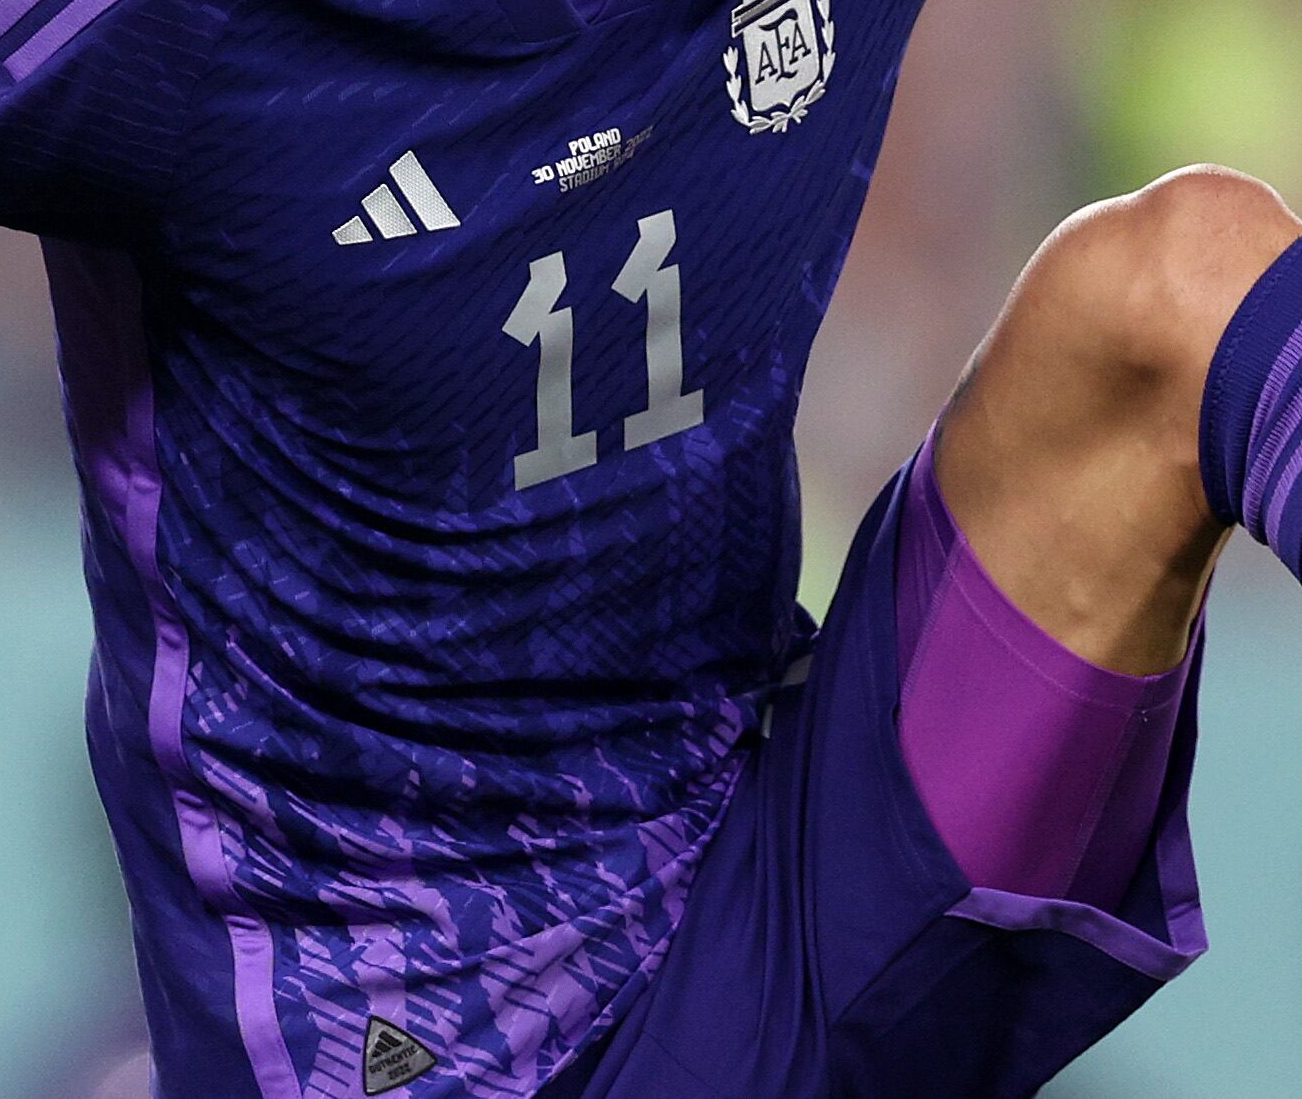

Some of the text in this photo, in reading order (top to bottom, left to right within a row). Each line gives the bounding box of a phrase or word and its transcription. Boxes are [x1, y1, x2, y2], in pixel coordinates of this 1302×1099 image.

[755, 7, 811, 85] AFA
[568, 127, 622, 156] POLAND
[531, 165, 555, 185] 30
[555, 144, 622, 177] NOVEMBER
[559, 164, 609, 192] STADIUM
[501, 208, 704, 491] 11
